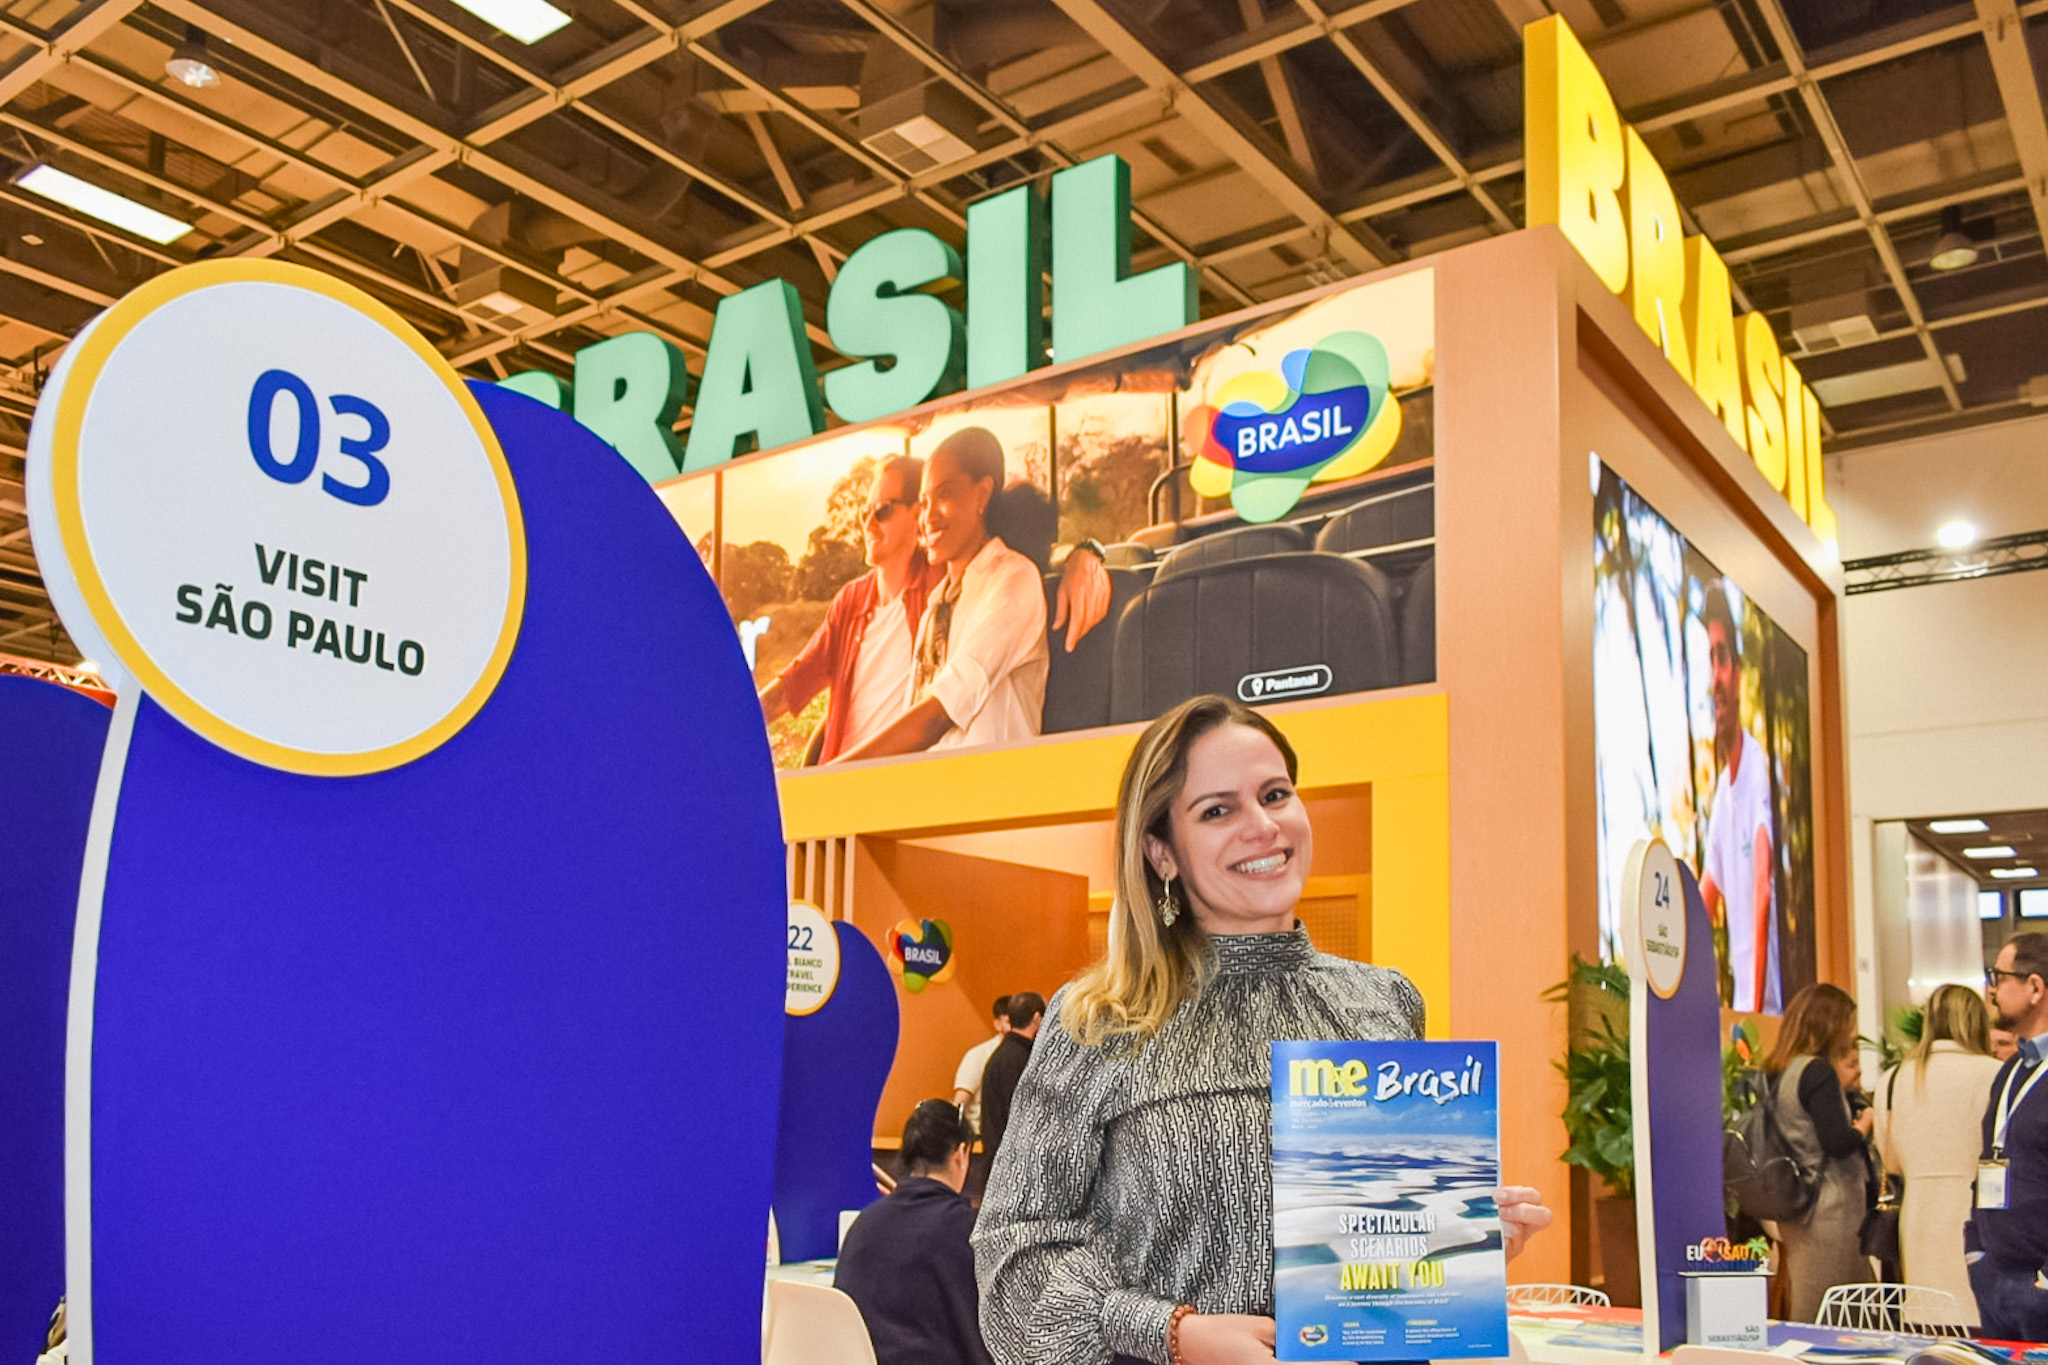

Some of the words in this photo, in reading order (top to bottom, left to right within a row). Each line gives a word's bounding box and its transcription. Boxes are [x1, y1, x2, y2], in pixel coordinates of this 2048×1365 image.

[1525, 13, 1838, 563] BRASIL
[247, 368, 391, 507] 03
[1237, 405, 1352, 458] BRASIL
[254, 542, 368, 608] VISIT
[174, 582, 273, 641] SÃO
[287, 609, 425, 677] PAULO
[1265, 671, 1319, 692] Pantanal
[1654, 871, 1670, 910] 24
[788, 924, 813, 951] 22
[794, 957, 823, 968] BIANCO
[904, 946, 943, 966] BRASIL
[787, 969, 814, 981] RAVEL
[1288, 1058, 1369, 1098] m&e
[1373, 1054, 1483, 1106] Brasil
[1339, 1211, 1437, 1235] SPECTACULAR
[1349, 1236, 1429, 1260] SCENARIOS
[1685, 1244, 1705, 1261] EU
[1340, 1262, 1401, 1291] AWAIT
[1406, 1260, 1446, 1289] YOU
